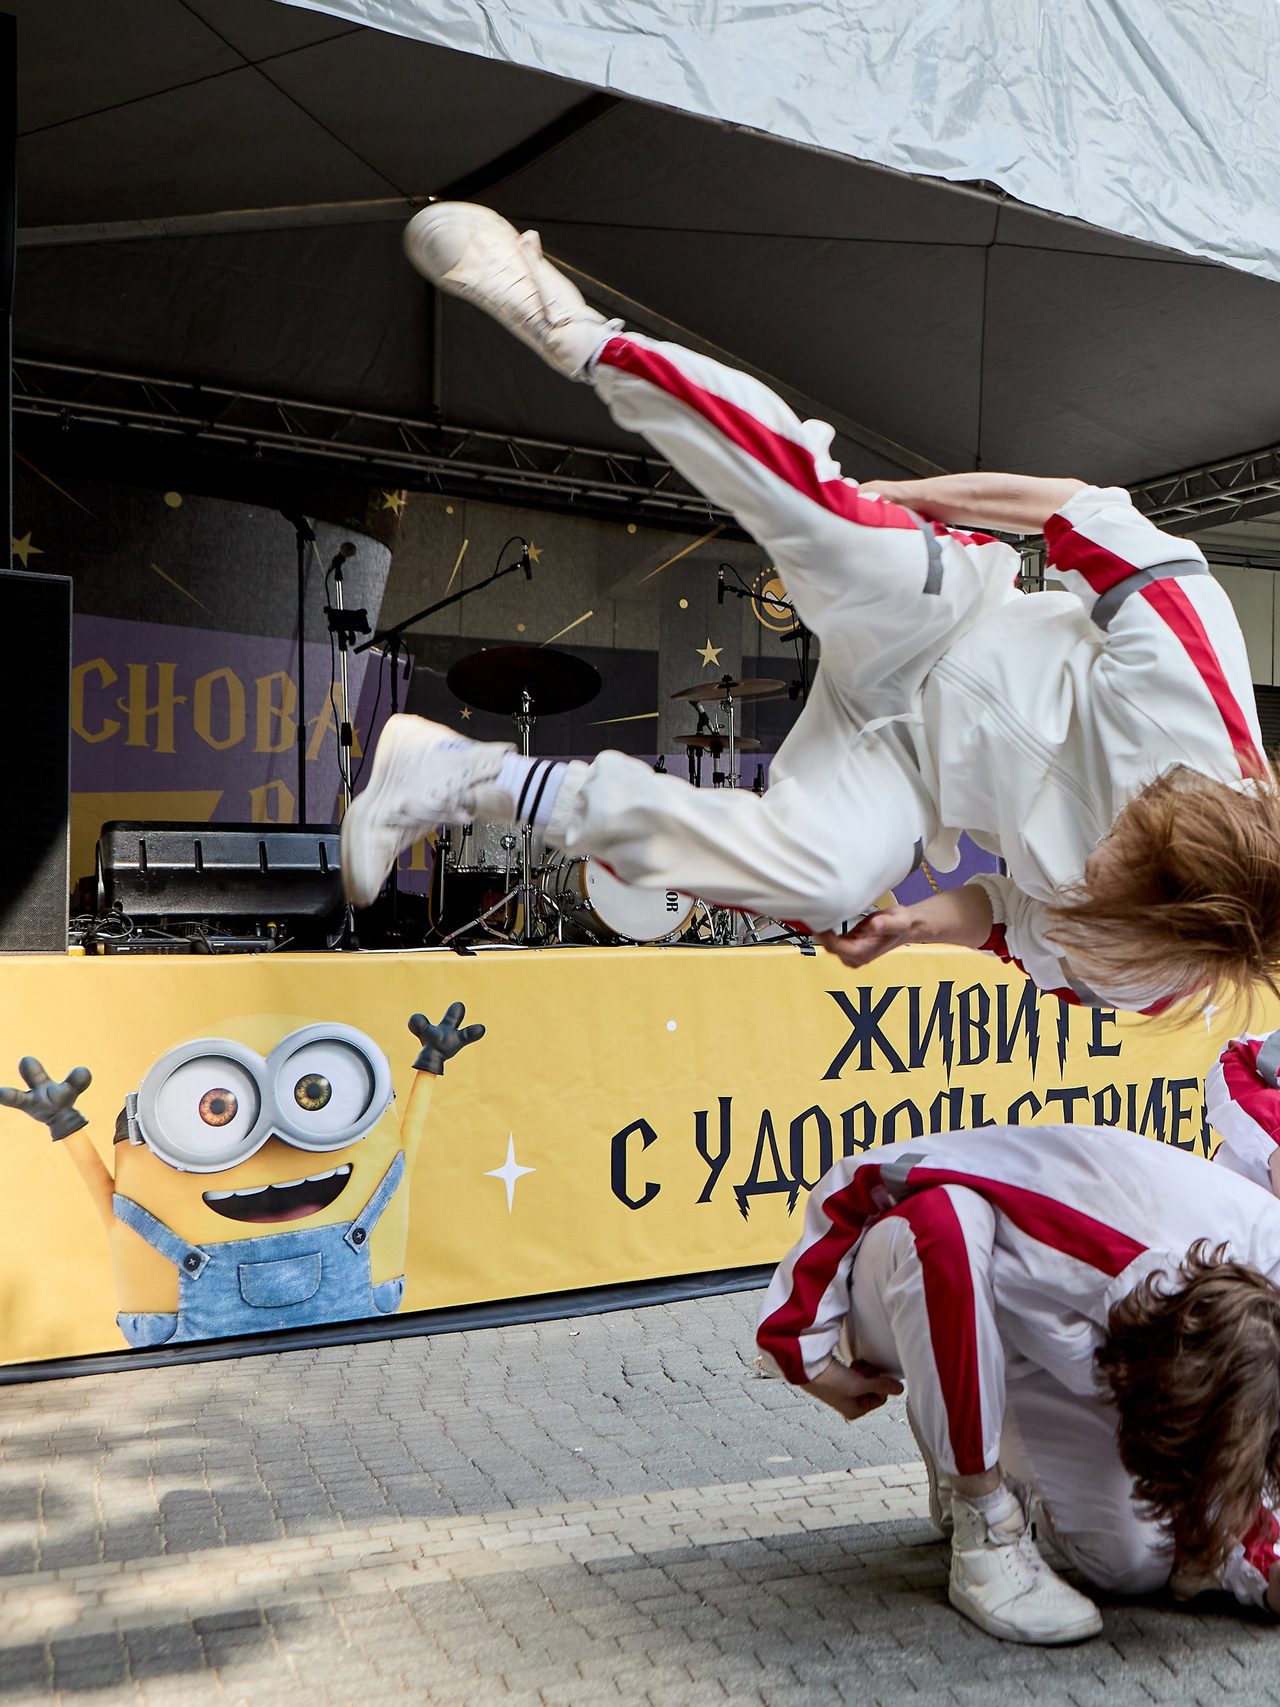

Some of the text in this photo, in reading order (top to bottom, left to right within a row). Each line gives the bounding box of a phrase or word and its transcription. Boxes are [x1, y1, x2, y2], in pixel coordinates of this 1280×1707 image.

[820, 980, 1123, 1087] ЖИВИТЕ
[610, 1076, 1213, 1222] С УДОВОЛТВИЕ
